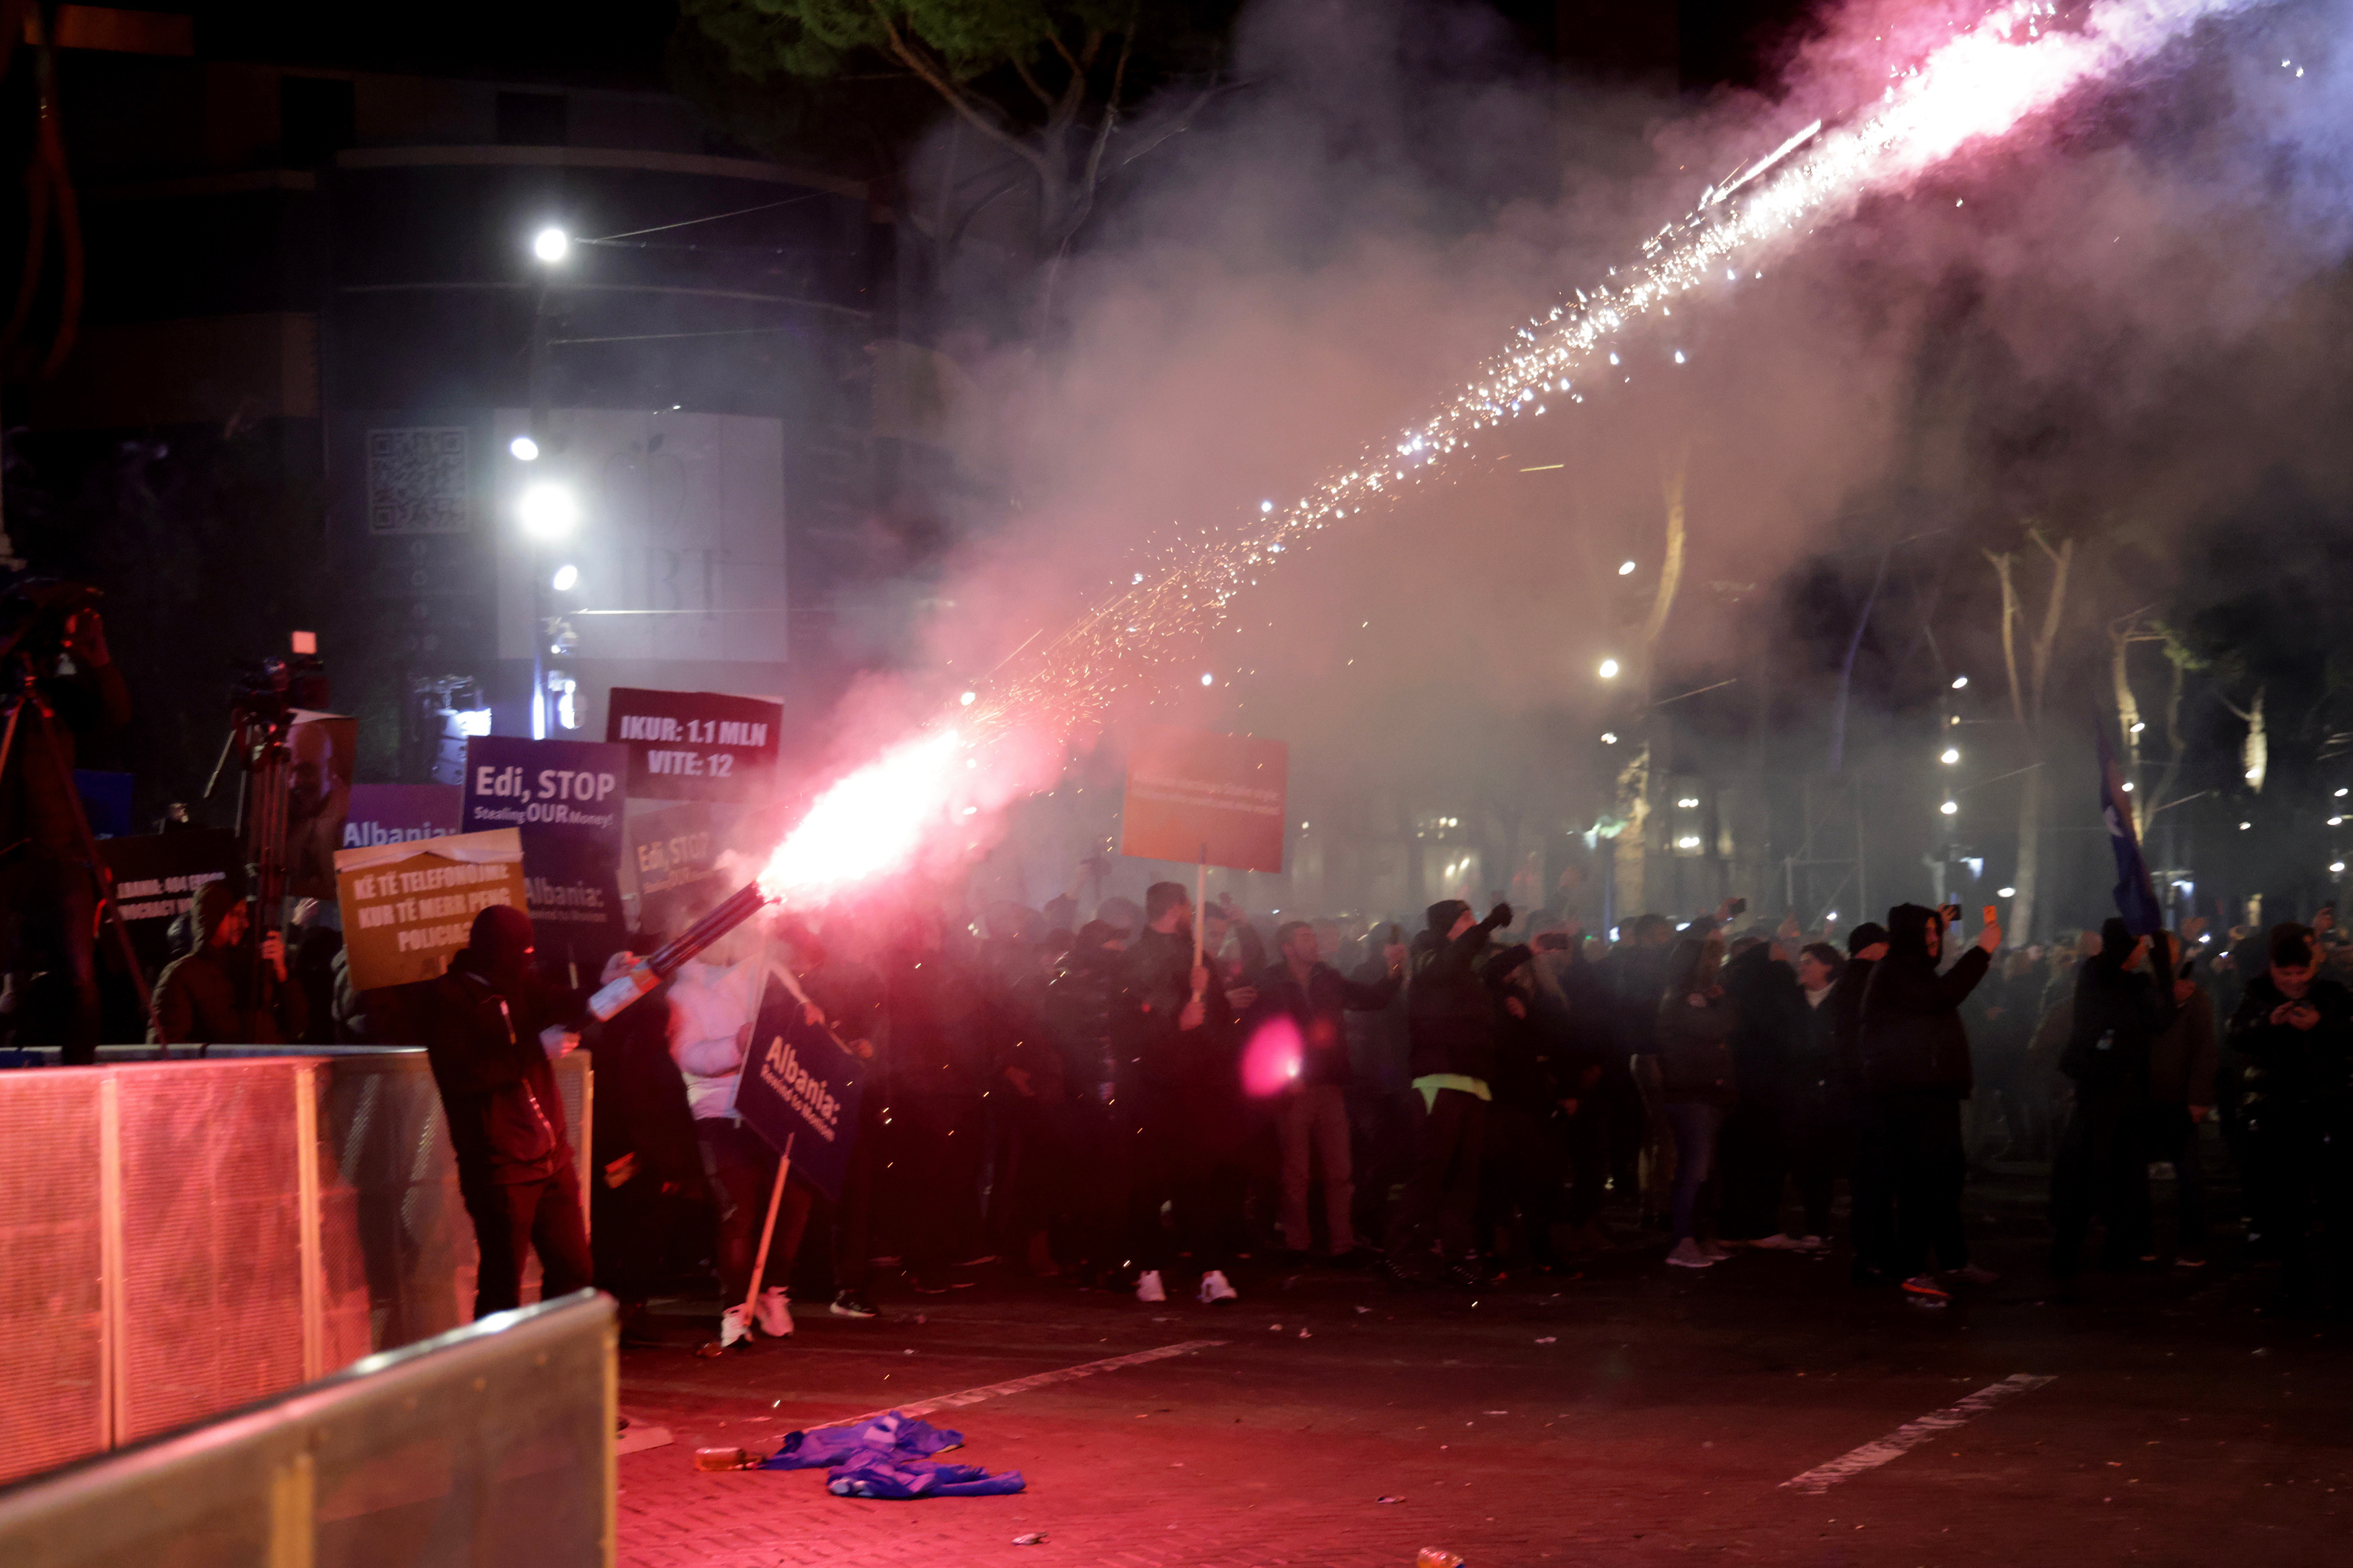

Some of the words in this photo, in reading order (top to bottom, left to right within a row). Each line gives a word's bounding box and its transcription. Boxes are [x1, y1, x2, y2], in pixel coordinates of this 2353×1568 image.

[620, 714, 684, 741] IKUR:
[687, 719, 716, 744] 1.1
[718, 720, 768, 747] MLN
[647, 749, 704, 776] VITE:
[707, 753, 734, 778] 12
[475, 766, 532, 804] Edi,
[538, 769, 616, 802] STOP
[526, 802, 569, 823] OUR
[638, 840, 669, 872] Edi,
[353, 872, 376, 901] KË
[376, 870, 399, 898] TË
[357, 904, 395, 930] KUR
[395, 897, 418, 923] TË
[417, 893, 467, 920] MERR
[765, 1035, 840, 1126] Albania:
